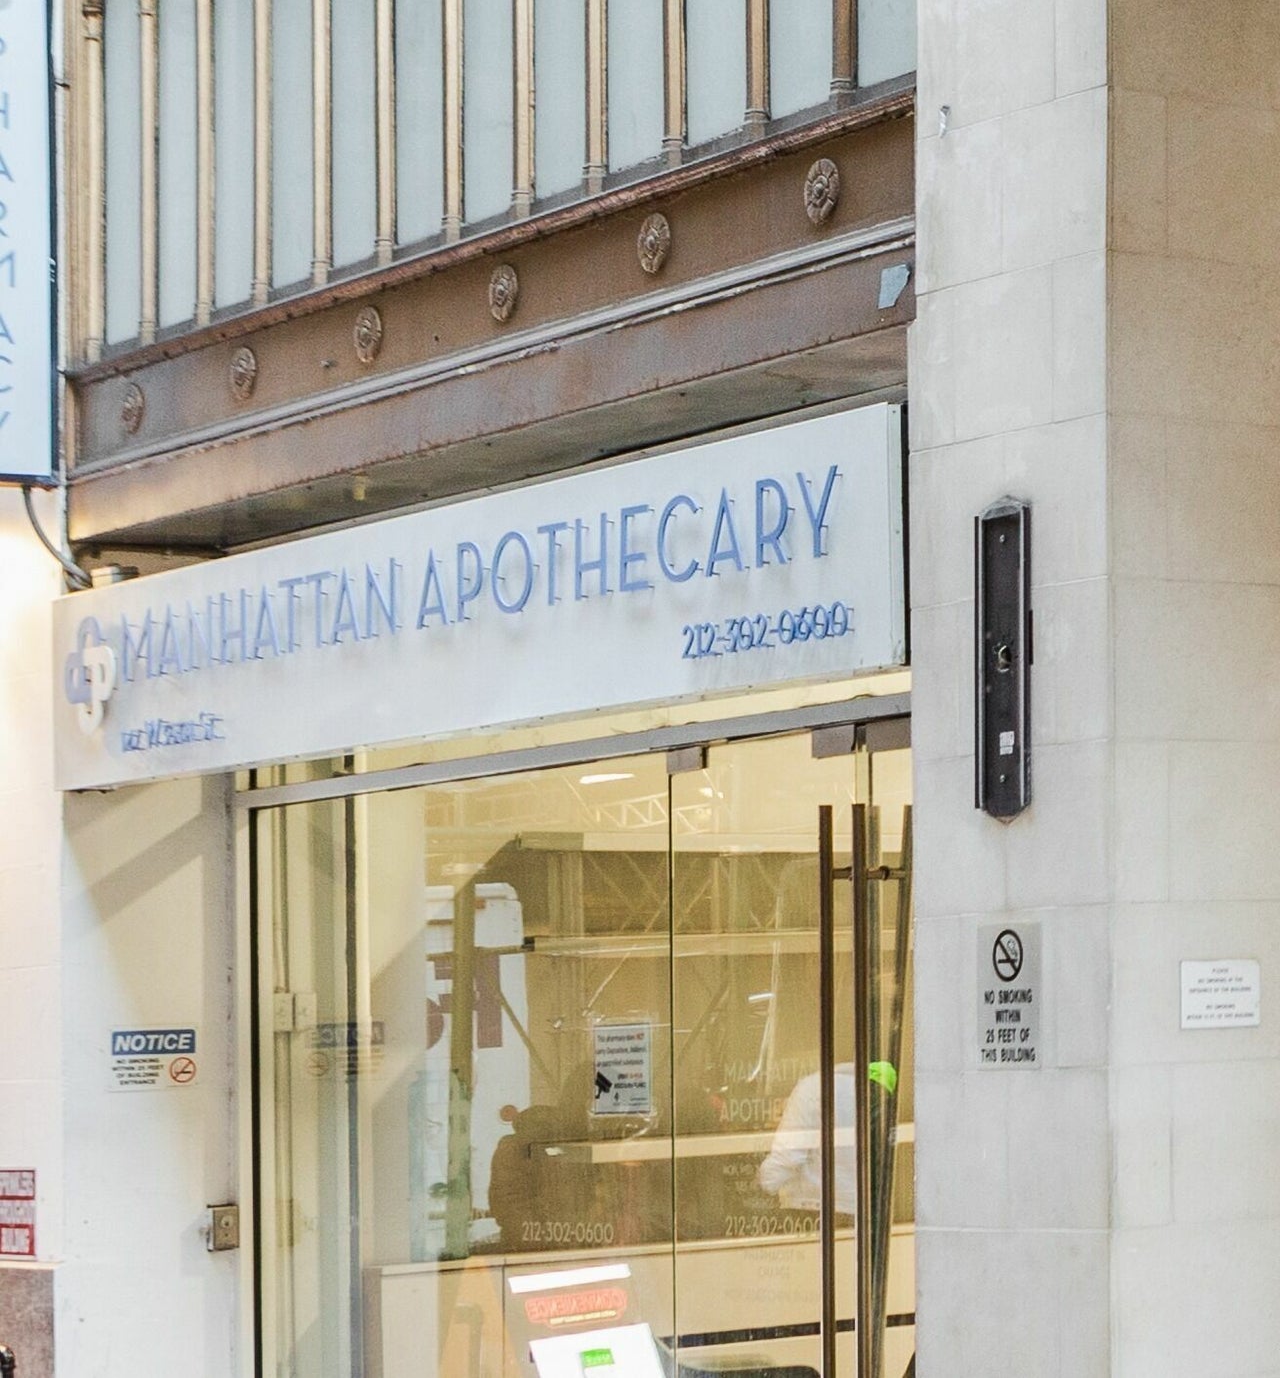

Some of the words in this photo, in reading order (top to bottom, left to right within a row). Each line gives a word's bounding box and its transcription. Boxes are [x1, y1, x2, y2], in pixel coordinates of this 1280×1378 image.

[121, 556, 398, 682] MANHATTAN
[415, 464, 840, 630] APOTHECARY
[682, 601, 853, 659] 212-302-0600
[984, 990, 995, 1004] NO
[998, 988, 1033, 1004] SMOKING
[995, 1009, 1021, 1023] WITHIN
[114, 1032, 193, 1052] NOTICE
[998, 1028, 1016, 1043] FEET
[1020, 1027, 1030, 1042] OF
[981, 1048, 997, 1062] THIS
[1001, 1047, 1036, 1062] BUILDING
[718, 1097, 784, 1123] APOTHE
[522, 1221, 615, 1244] 212-302-0600
